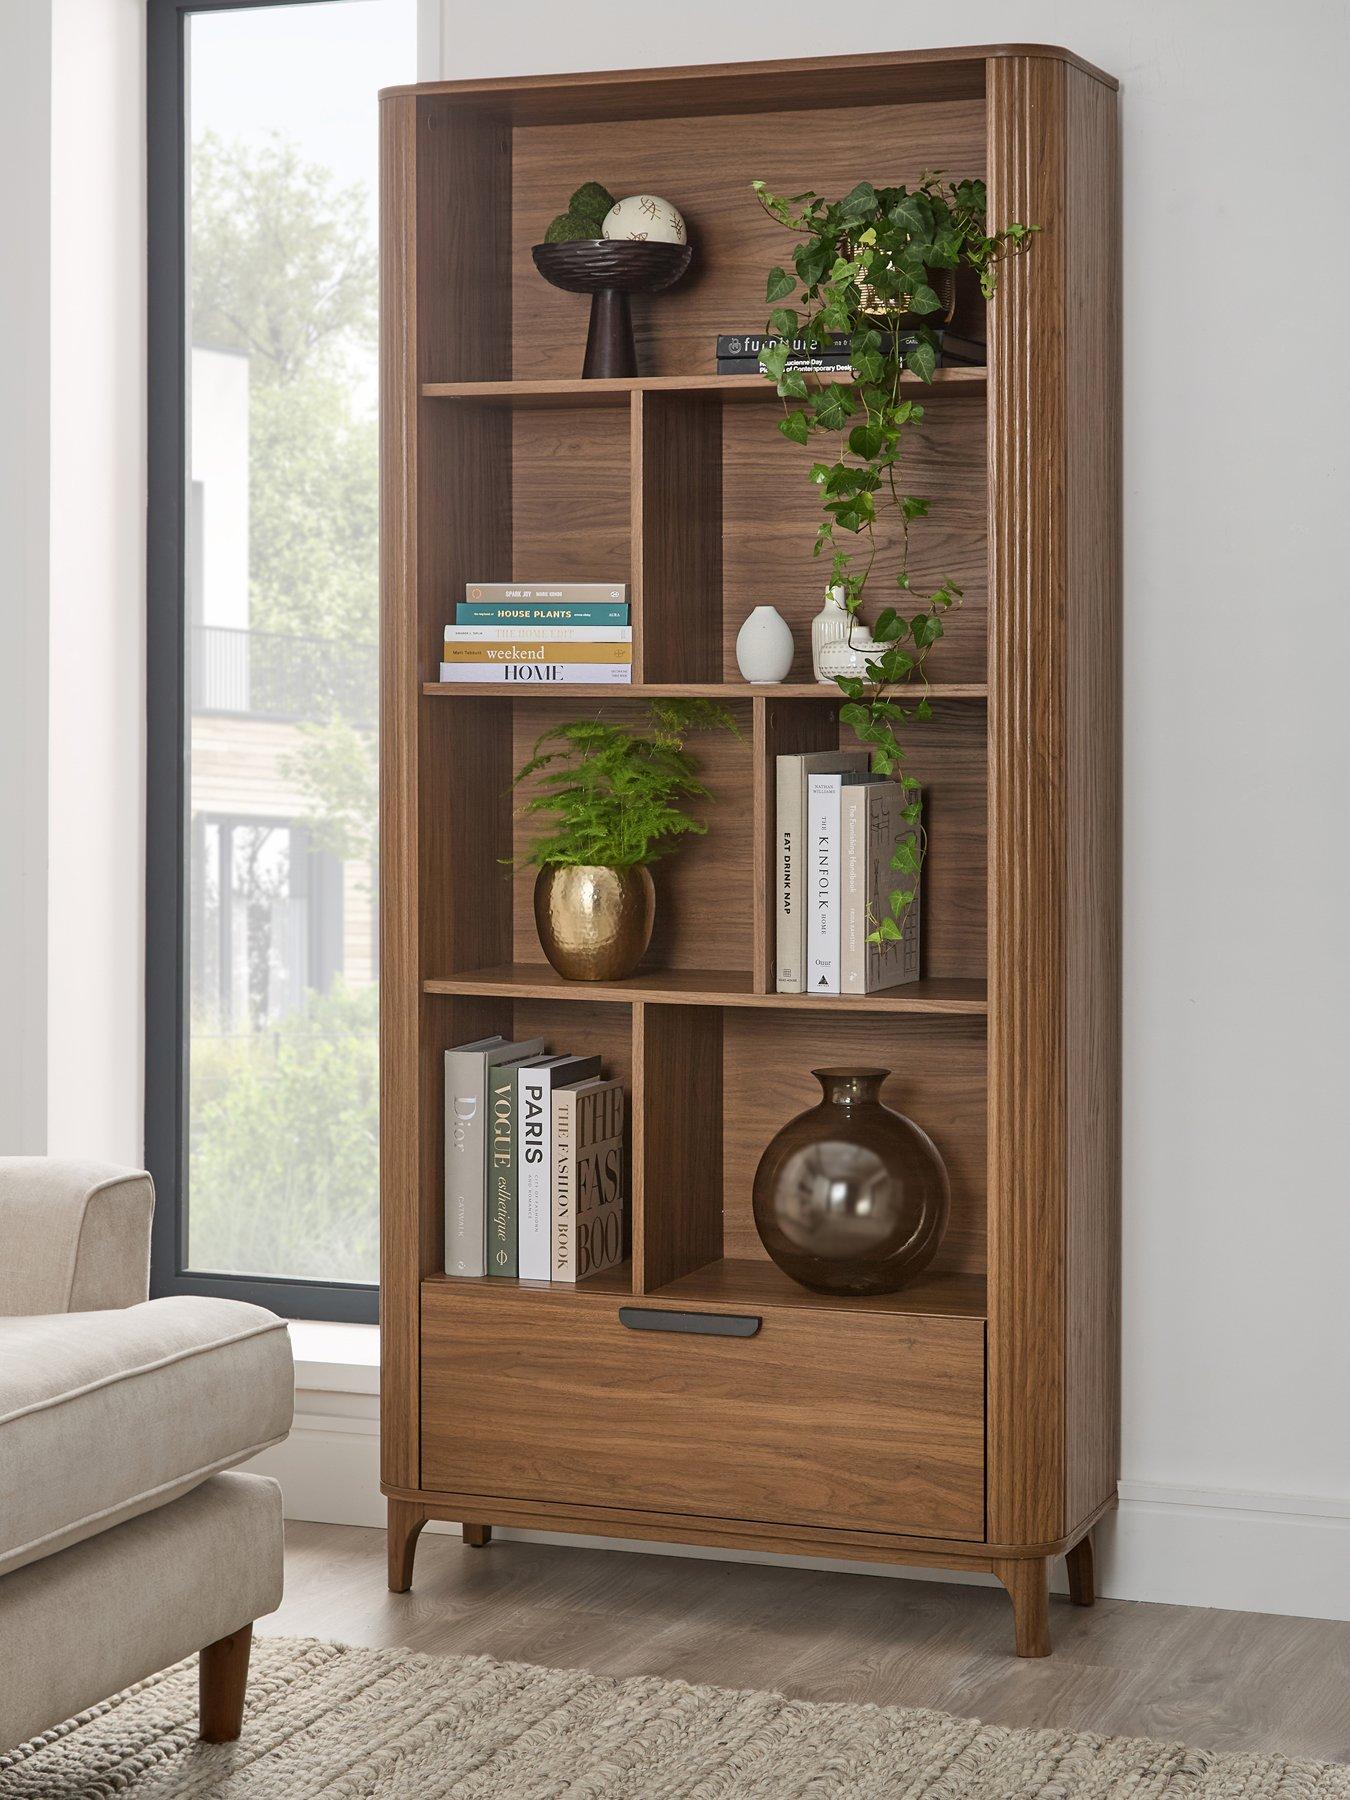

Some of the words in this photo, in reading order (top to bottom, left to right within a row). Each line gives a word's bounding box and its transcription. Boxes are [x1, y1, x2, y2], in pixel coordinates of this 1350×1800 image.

[786, 365, 793, 373] of
[811, 358, 823, 367] Day
[497, 610, 530, 618] HOUSE
[534, 610, 572, 618] PLANTS
[486, 645, 545, 660] weekend
[504, 665, 564, 680] HOME
[819, 836, 829, 910] KINFOLK
[453, 1095, 477, 1153] Dior
[494, 1083, 512, 1168] VOGUE
[525, 1085, 543, 1164] PARIS
[558, 1104, 569, 1138] THE
[576, 1086, 624, 1149] THE
[558, 1143, 569, 1217] FASHION
[576, 1146, 624, 1215] FAS
[457, 1195, 465, 1240] CATWALK
[576, 1208, 622, 1278] BOO
[558, 1223, 569, 1269] BOOK
